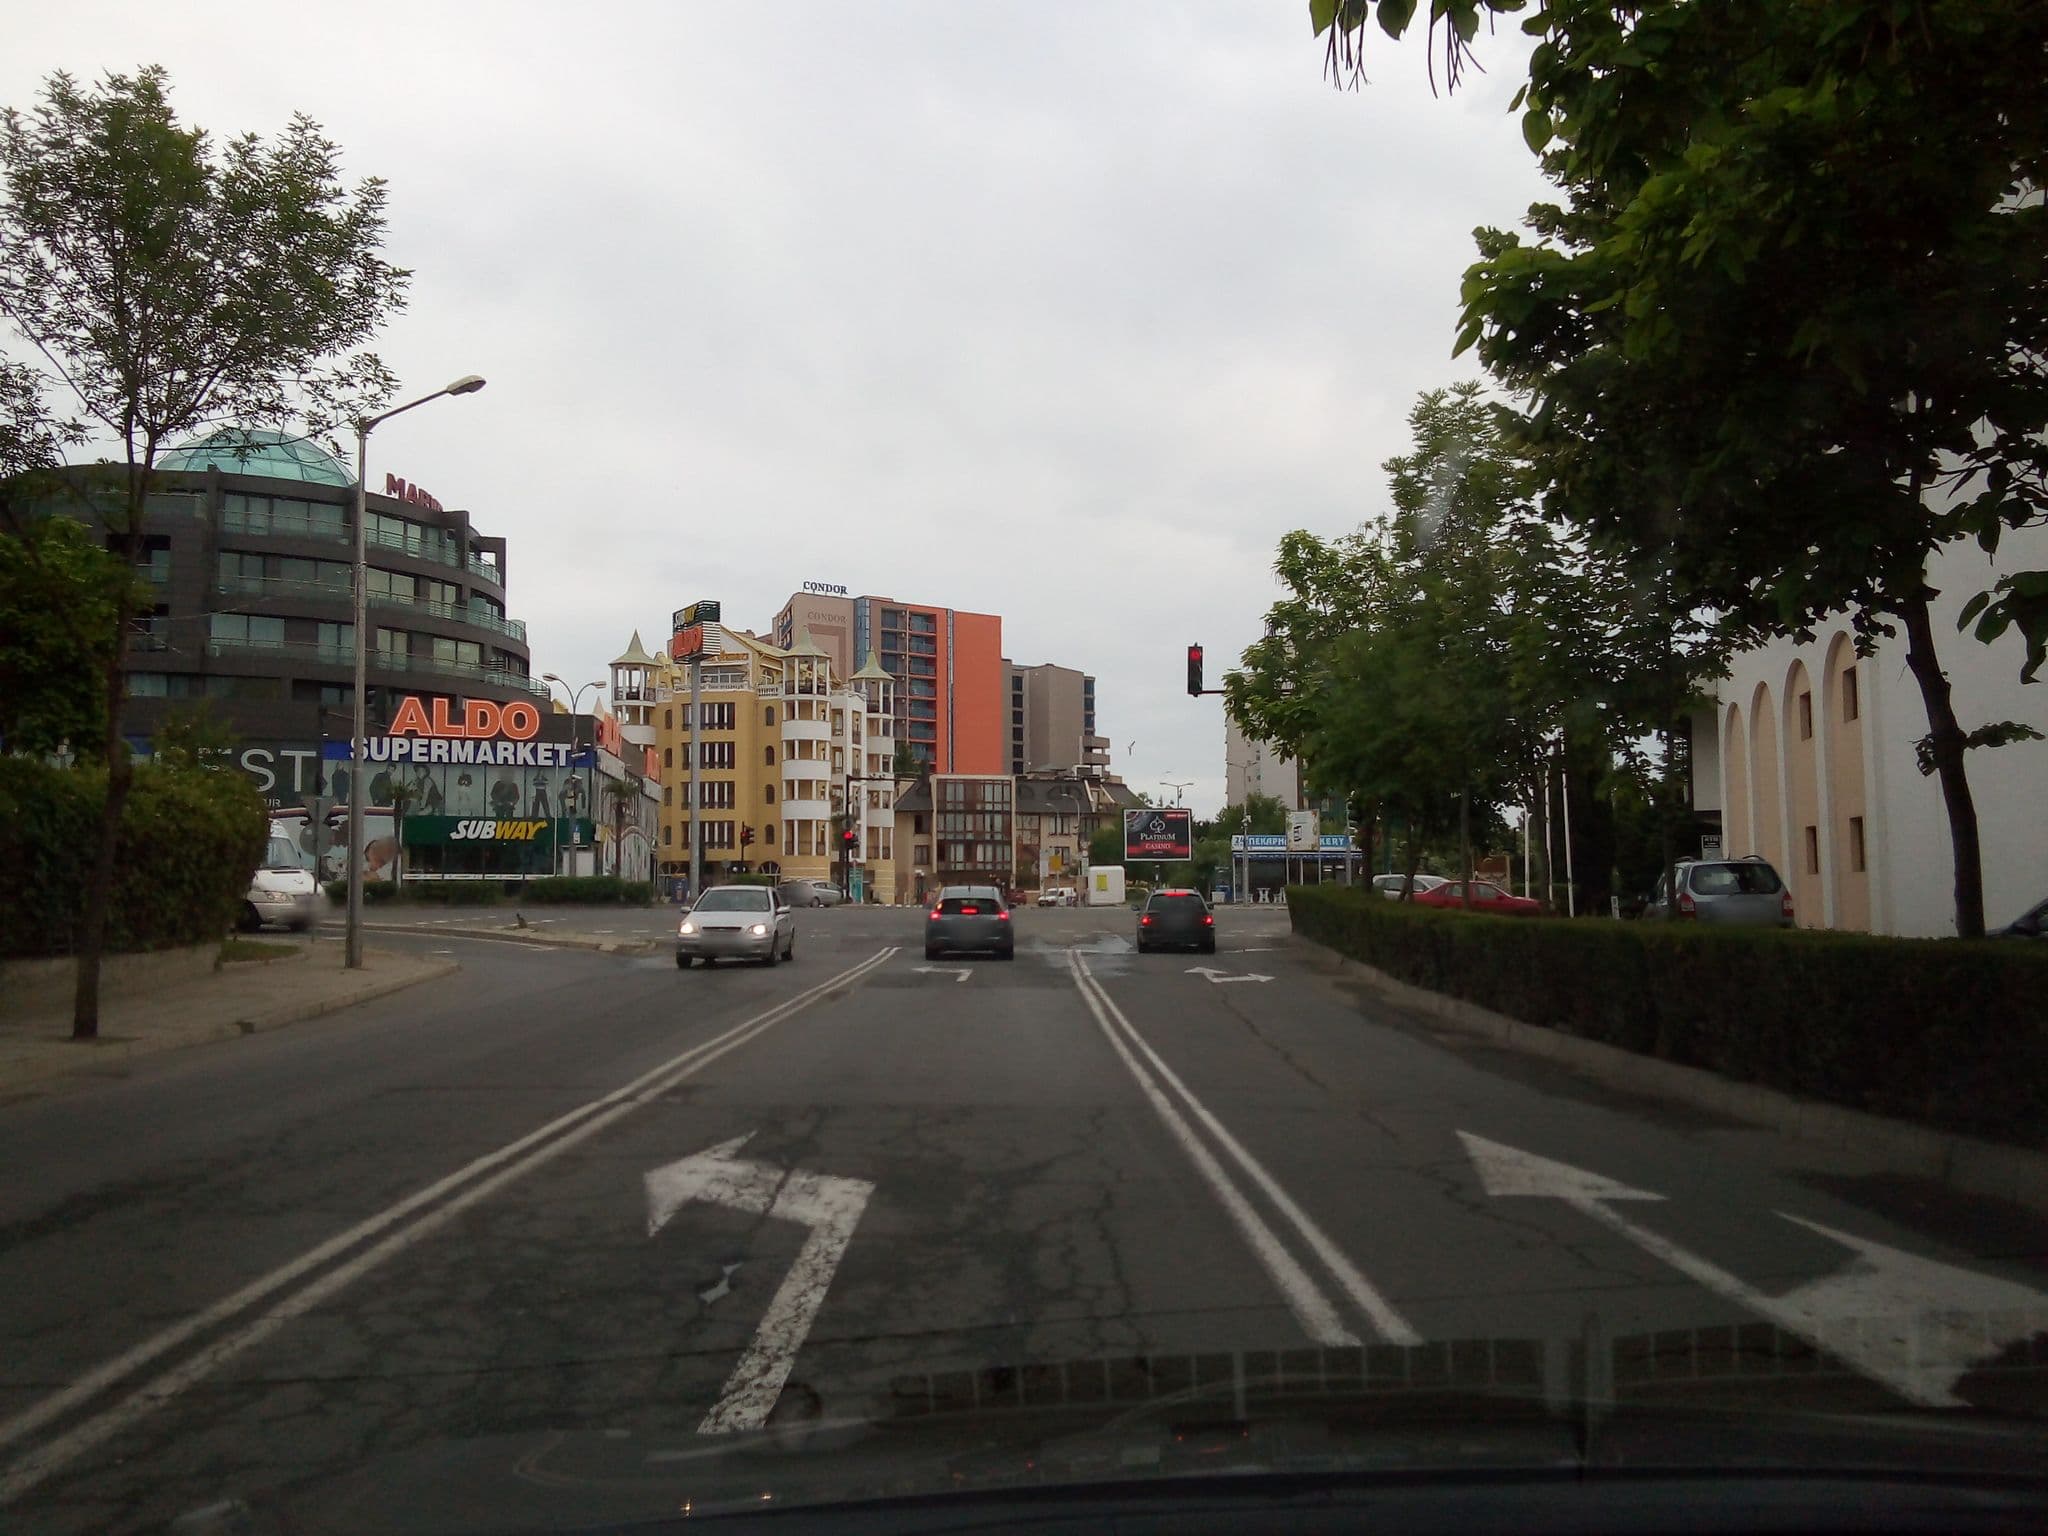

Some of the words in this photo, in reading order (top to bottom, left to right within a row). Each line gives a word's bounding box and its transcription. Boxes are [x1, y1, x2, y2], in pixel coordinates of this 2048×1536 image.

[803, 581, 848, 595] CONDOR
[807, 611, 848, 624] CONDOR
[389, 695, 540, 741] ALDO
[451, 819, 548, 840] SUBWAY
[1140, 832, 1176, 841] PLATINUM
[1248, 837, 1287, 846] ПЕКАРН
[1319, 837, 1345, 846] KERY
